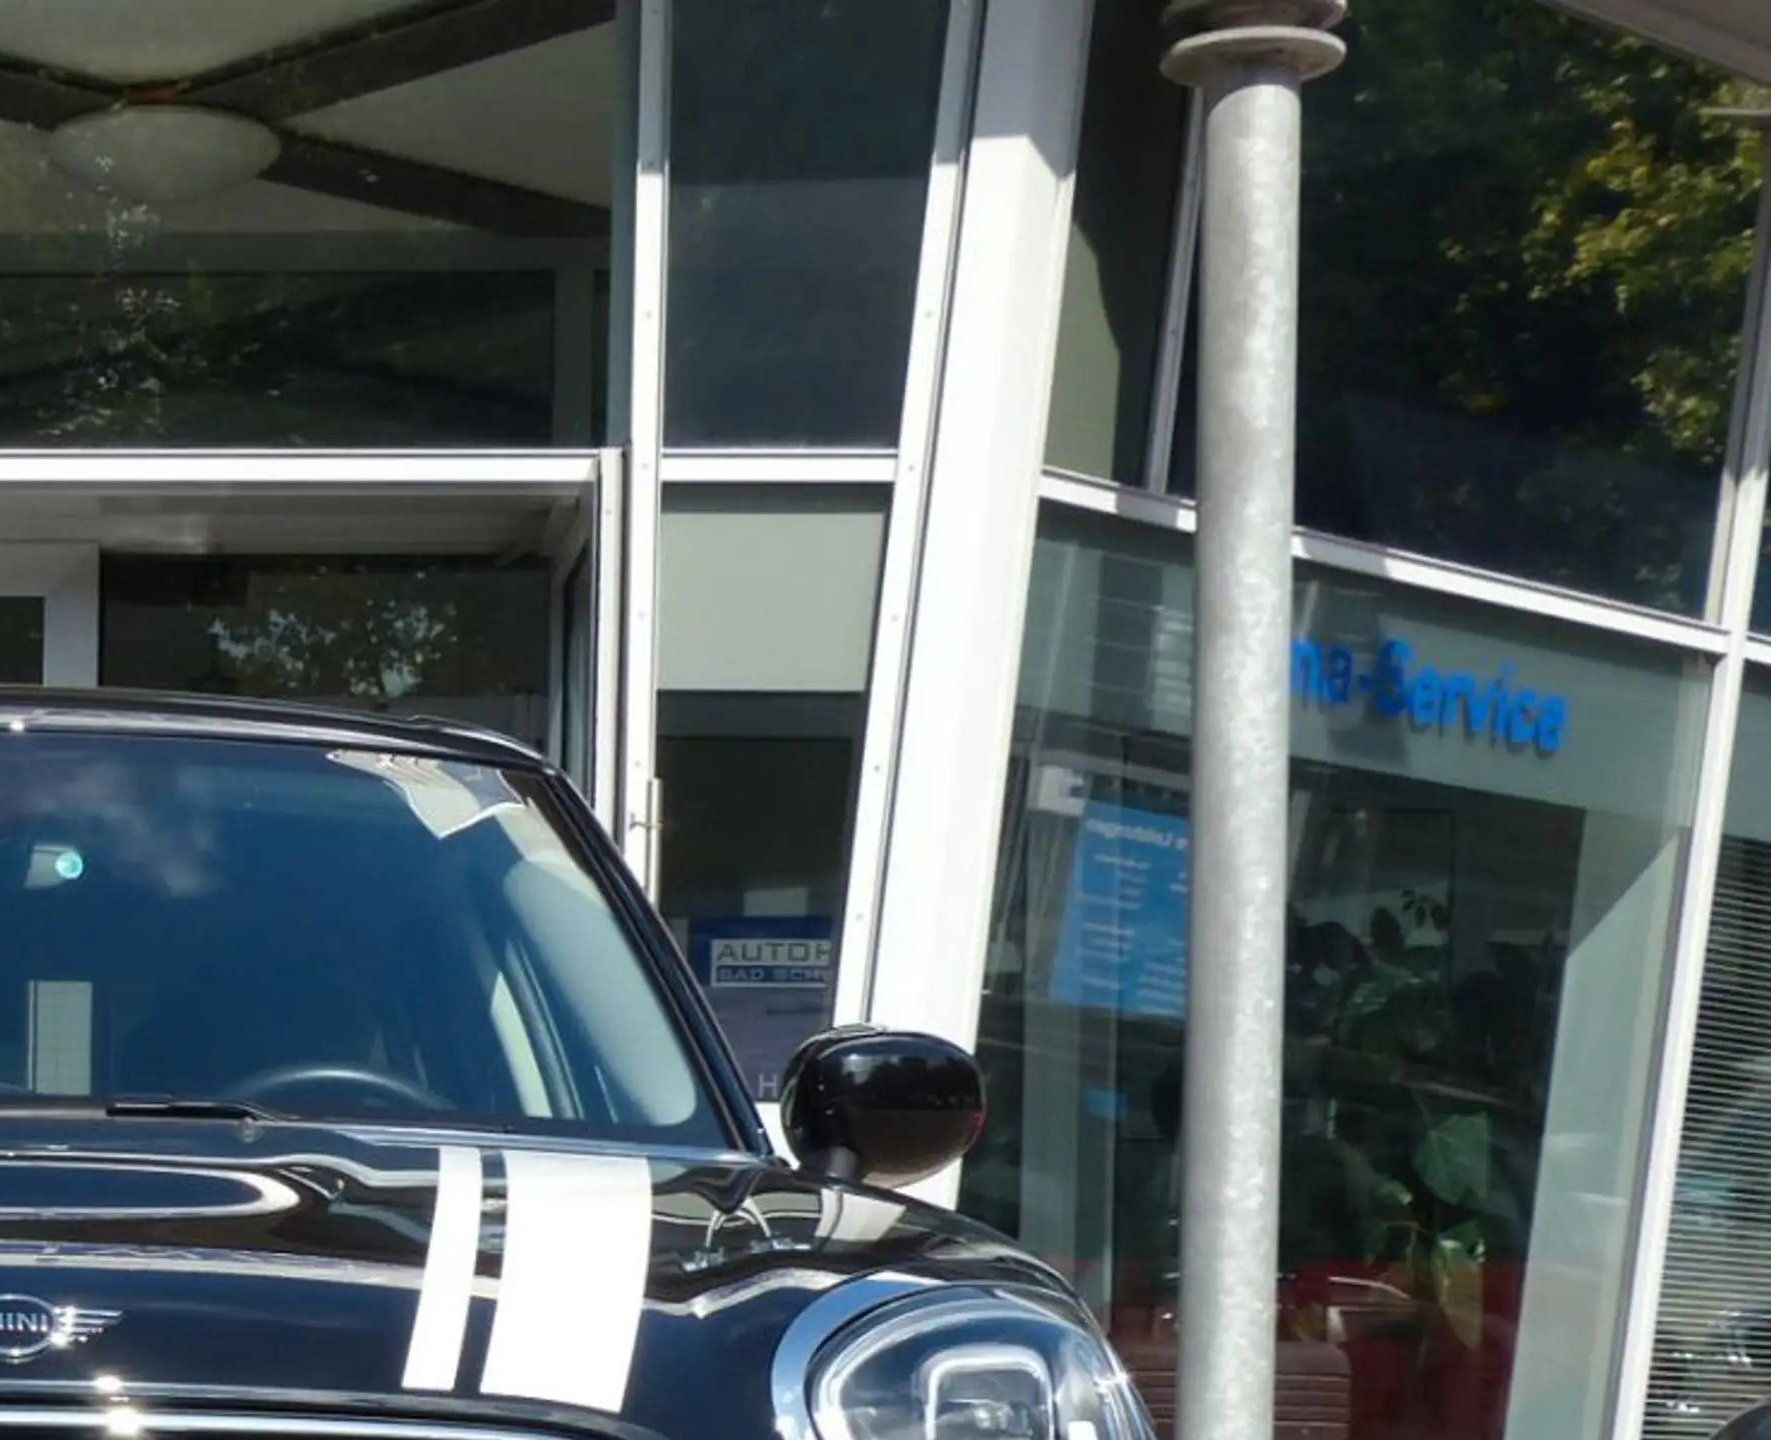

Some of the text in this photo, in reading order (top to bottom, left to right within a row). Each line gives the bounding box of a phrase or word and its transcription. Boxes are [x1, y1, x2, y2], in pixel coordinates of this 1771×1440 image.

[1289, 638, 1566, 754] na-Service
[715, 942, 832, 962] AUTOH
[772, 967, 833, 982] SCH
